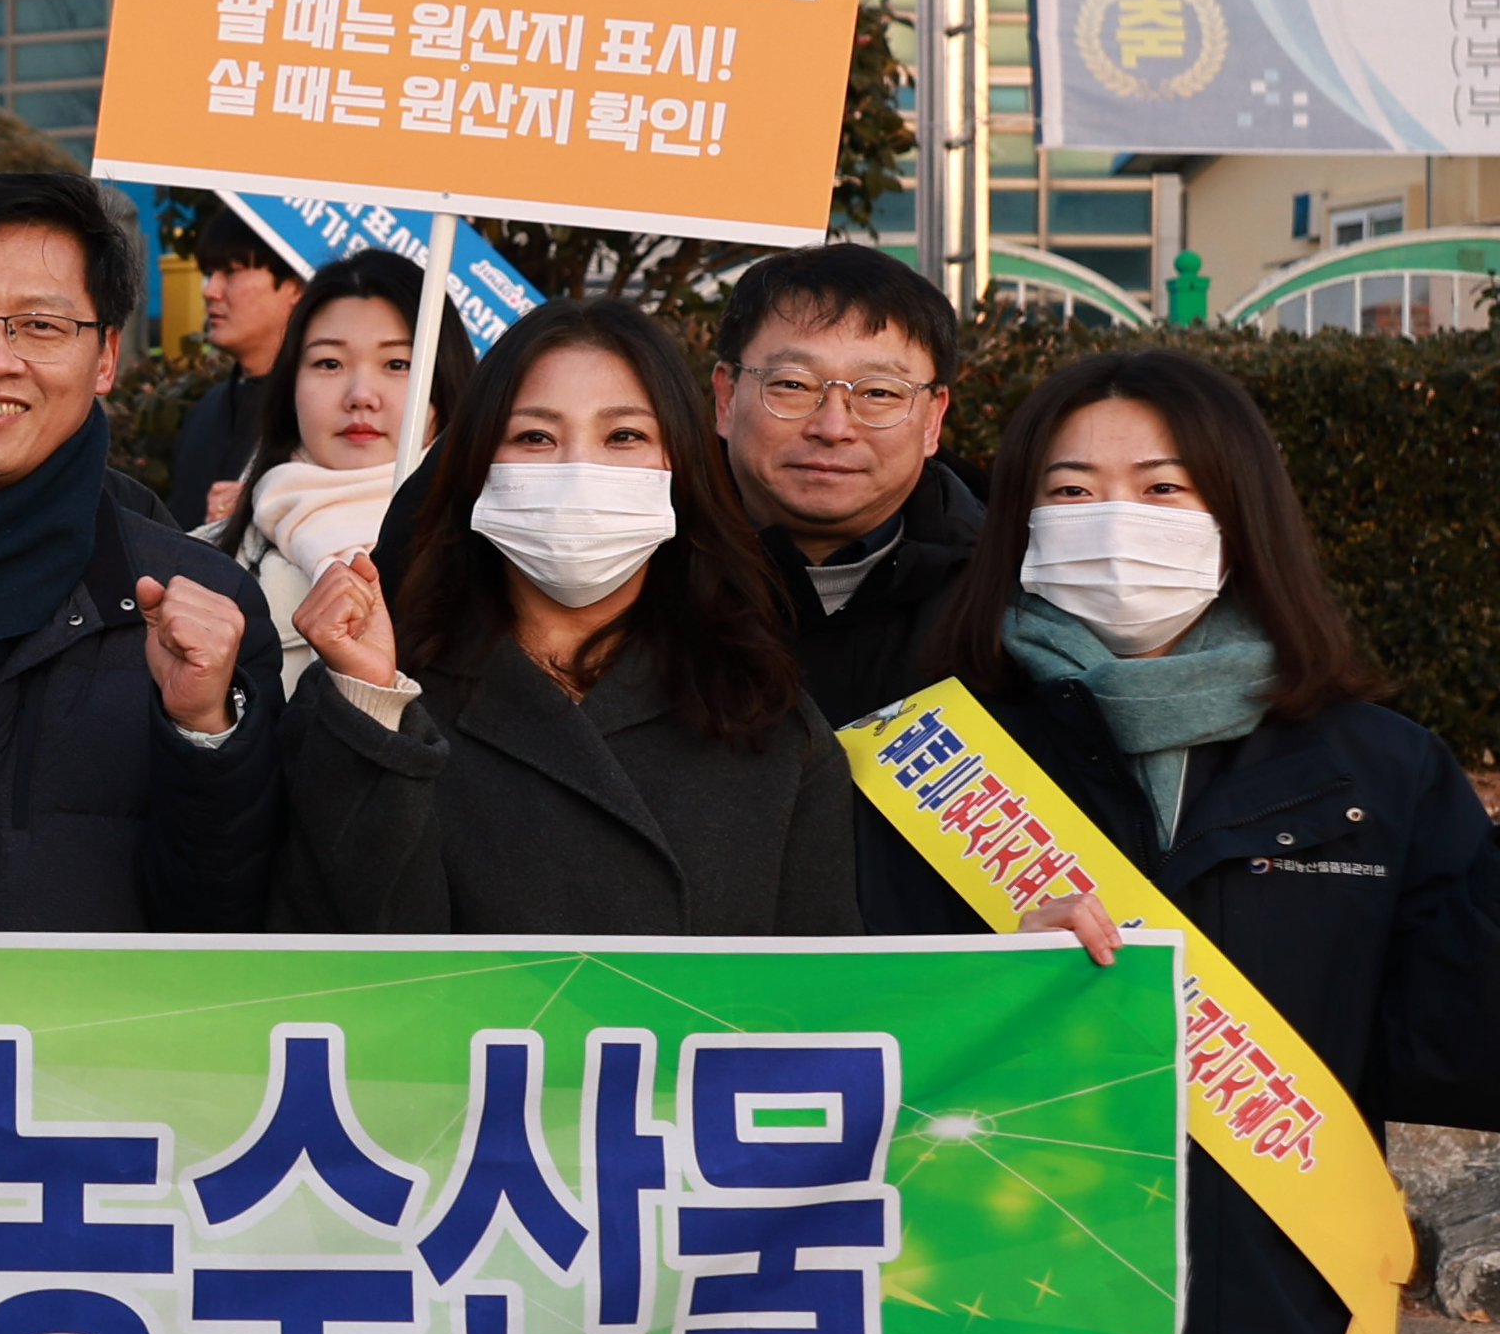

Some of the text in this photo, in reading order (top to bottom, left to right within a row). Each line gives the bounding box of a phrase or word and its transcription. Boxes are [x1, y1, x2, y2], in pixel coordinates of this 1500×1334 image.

[409, 1, 585, 73] 원산지
[596, 21, 736, 83] 표시!
[208, 58, 726, 158] 살 때는 원산지 확인!
[1273, 858, 1388, 877] 국립농산물품질관리원
